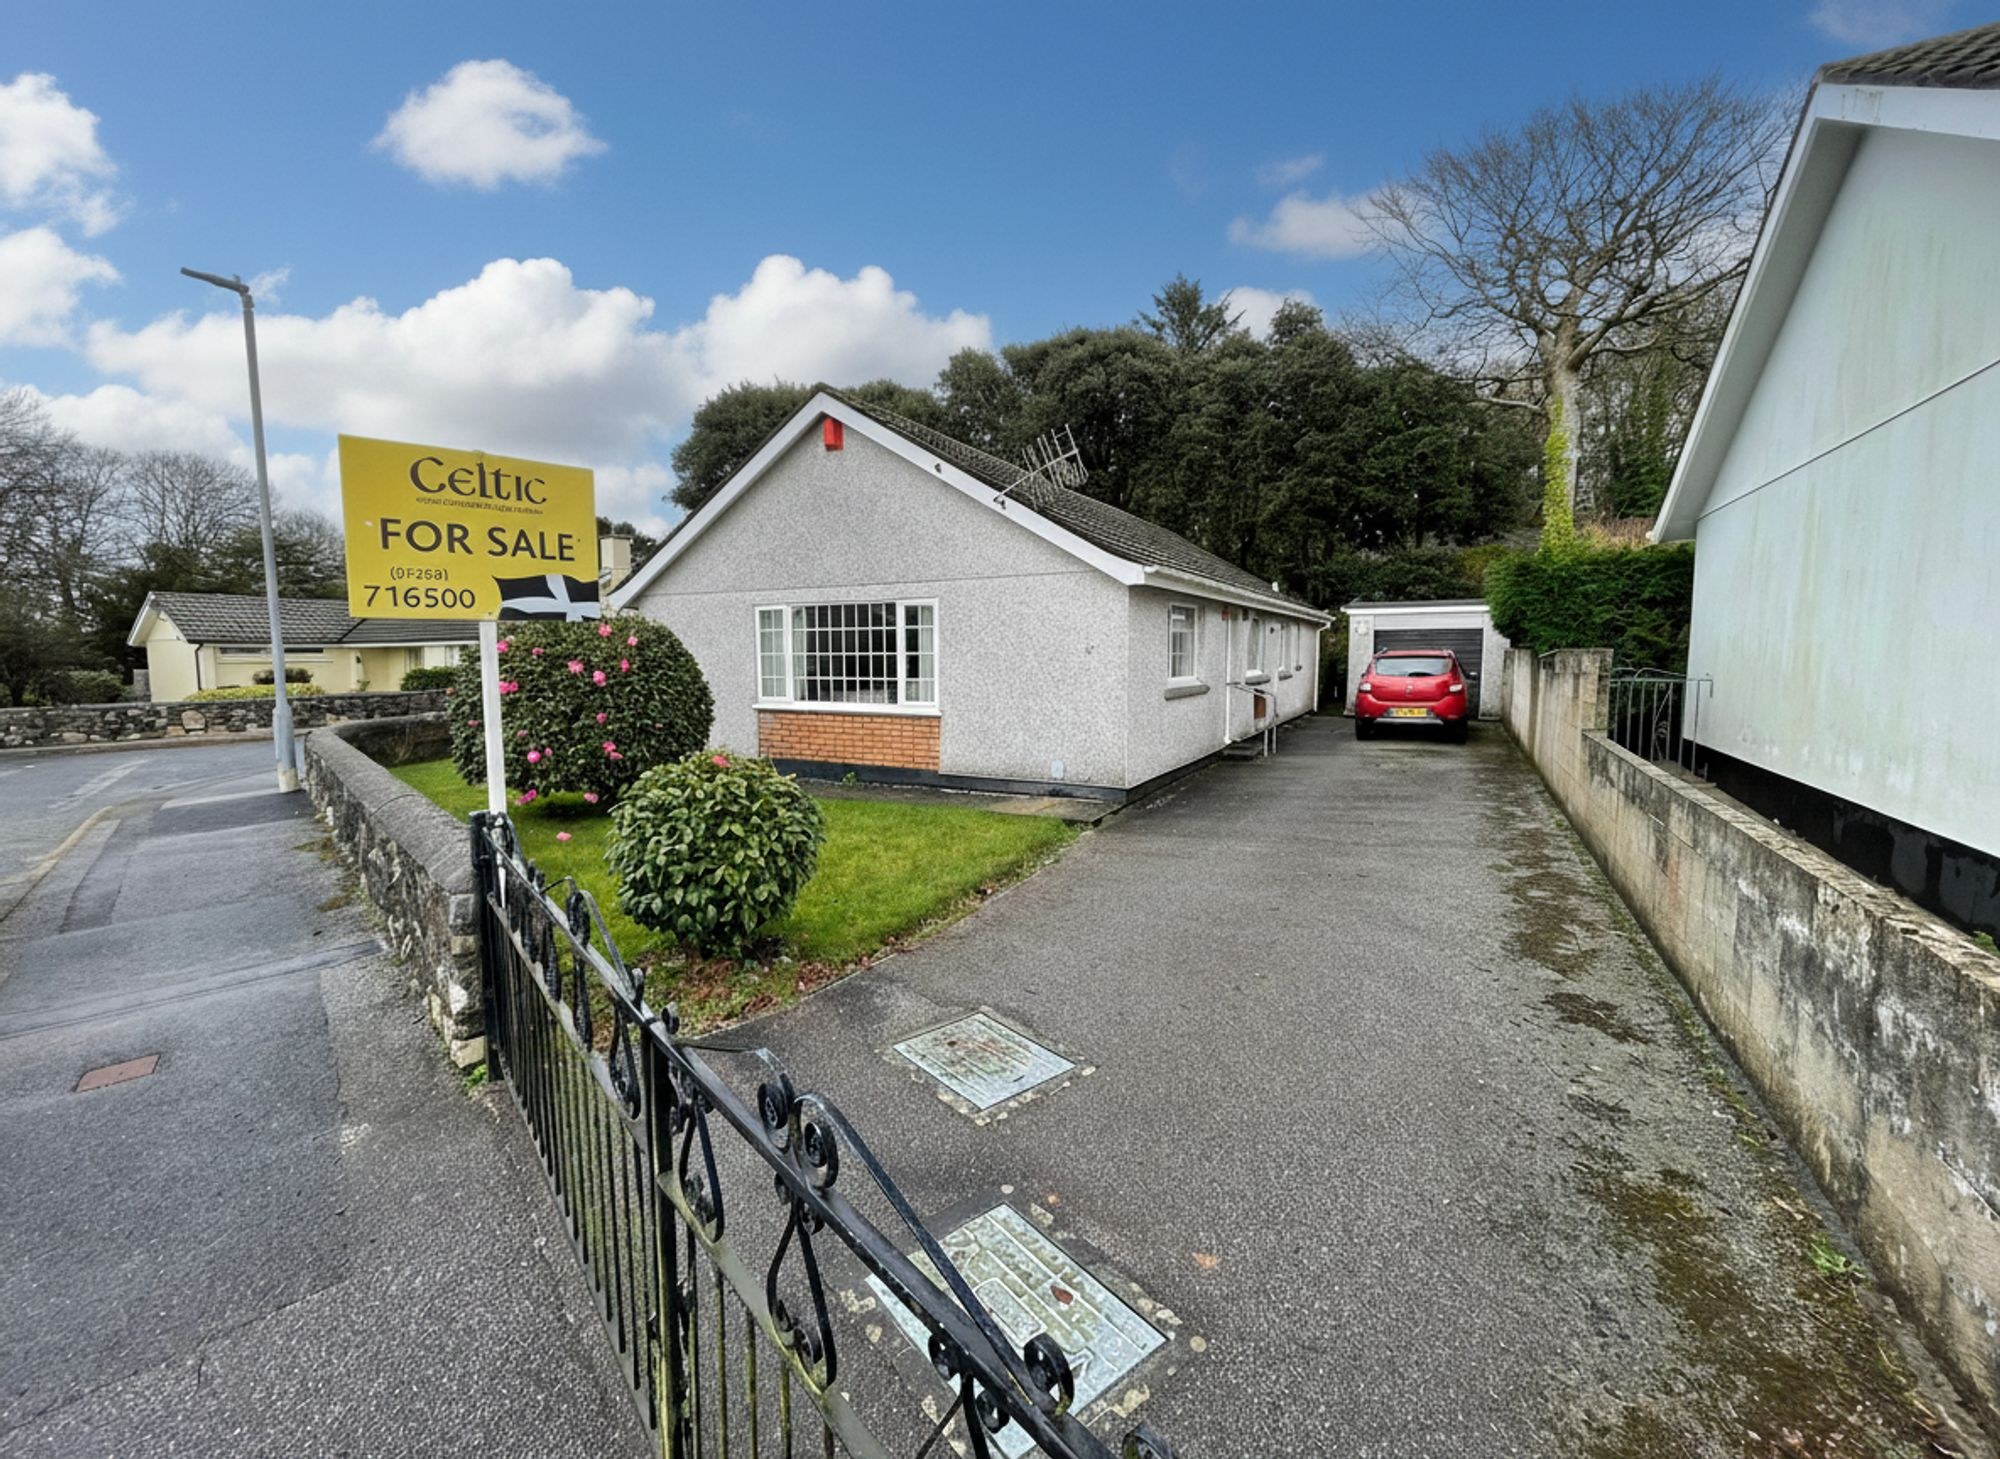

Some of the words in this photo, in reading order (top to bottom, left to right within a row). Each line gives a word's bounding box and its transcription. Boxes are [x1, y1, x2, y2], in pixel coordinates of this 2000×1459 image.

[380, 518, 473, 555] FOR
[487, 526, 575, 562] SALE
[363, 585, 476, 609] 716500
